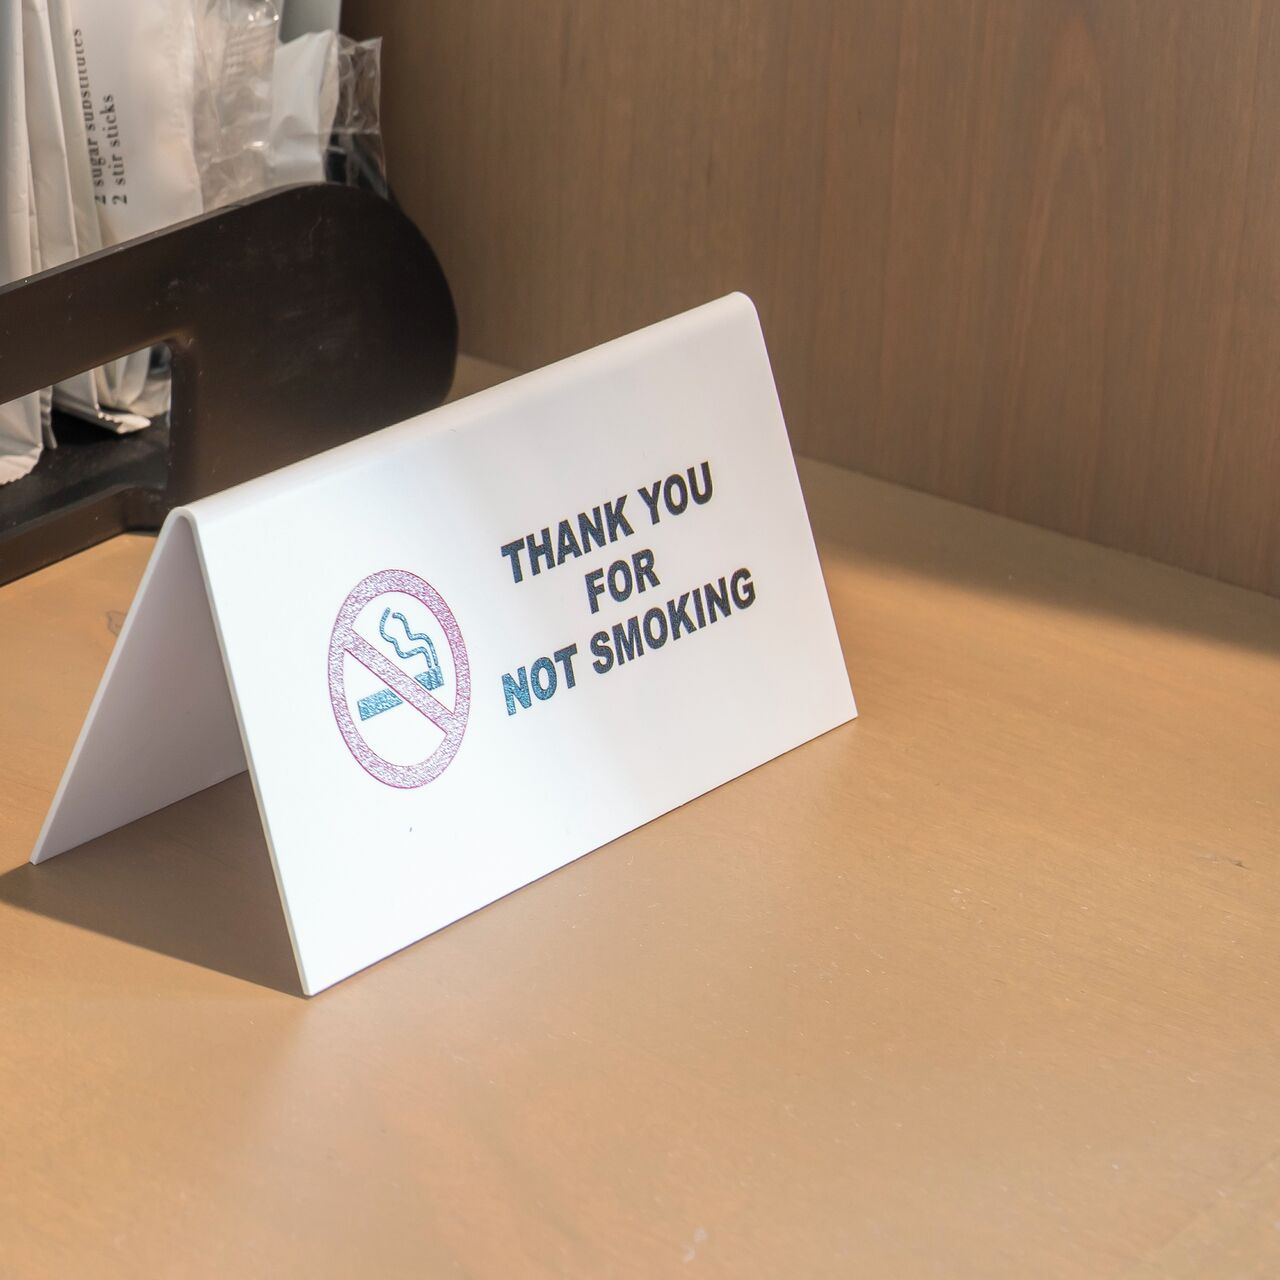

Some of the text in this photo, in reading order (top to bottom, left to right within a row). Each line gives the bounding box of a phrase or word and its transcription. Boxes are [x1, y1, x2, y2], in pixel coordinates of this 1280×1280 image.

[87, 138, 107, 187] sugar
[100, 94, 128, 206] 2 stir sticks
[500, 461, 713, 584] THANK YOU
[584, 548, 661, 614] FOR
[501, 567, 756, 716] NOT SMOKING
